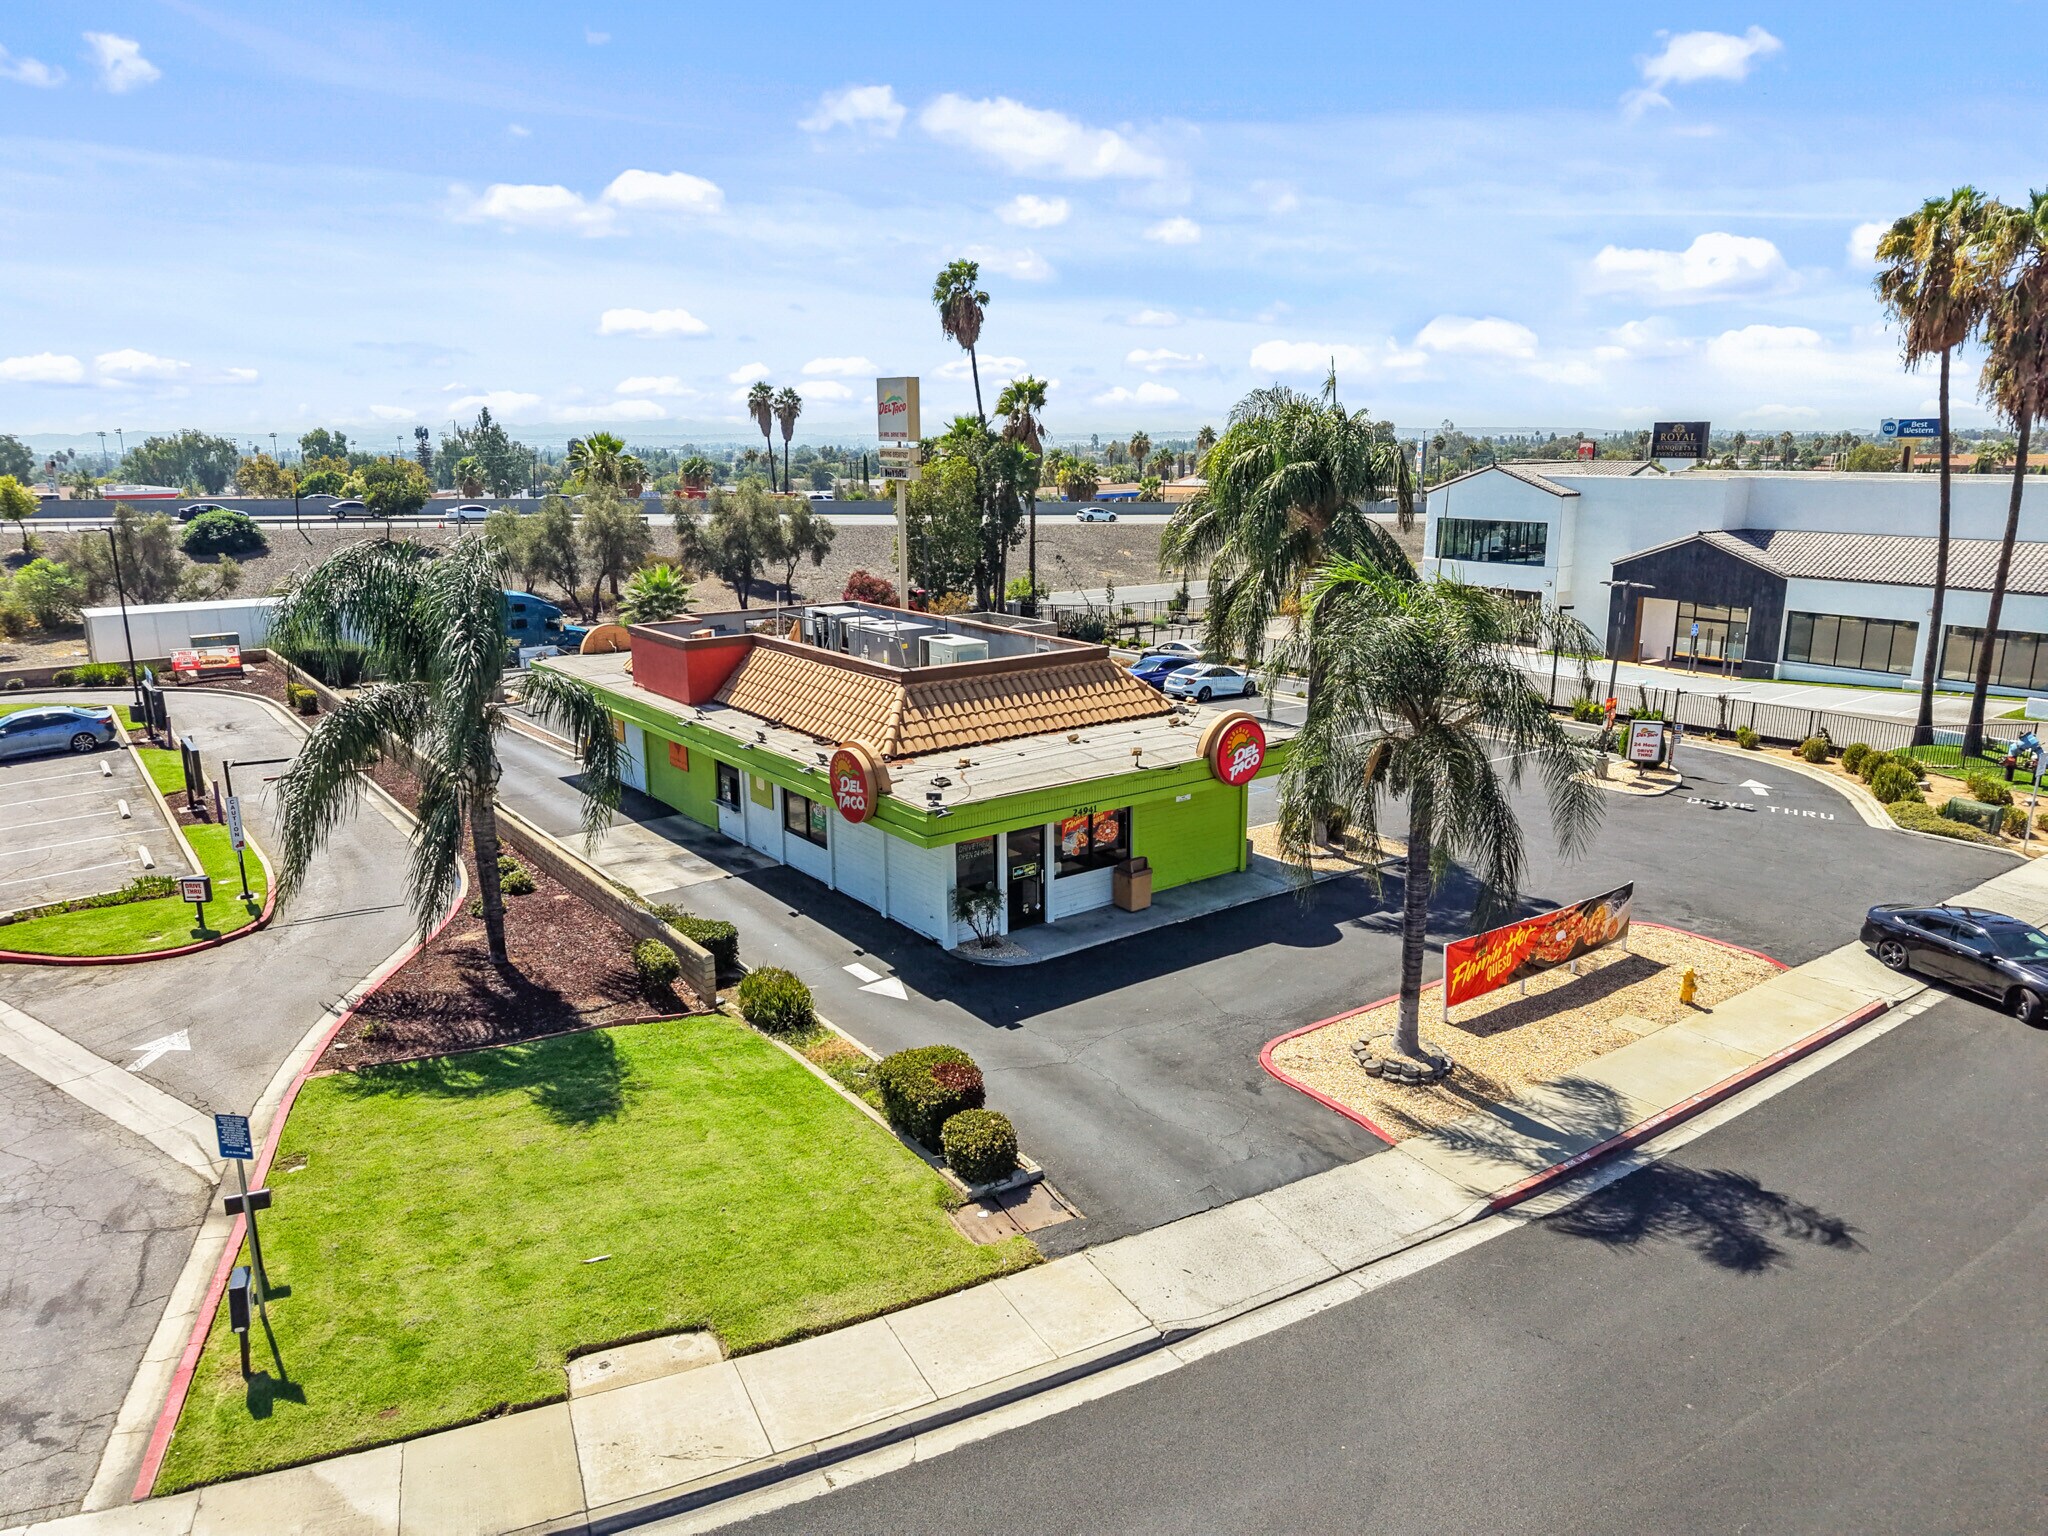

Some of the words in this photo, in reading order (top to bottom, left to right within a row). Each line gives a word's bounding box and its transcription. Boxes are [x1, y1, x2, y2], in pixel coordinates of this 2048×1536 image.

[1911, 420, 1928, 428] Best
[1660, 432, 1697, 441] ROYAL
[1656, 444, 1691, 452] BANQUETS
[1233, 743, 1260, 766] DEL
[1229, 753, 1260, 781] TACO
[840, 776, 863, 793] DEL
[837, 792, 865, 810] TACO
[1686, 796, 1754, 811] DRIVE
[1766, 805, 1835, 821] THRU
[230, 799, 240, 838] CAUTION
[1073, 804, 1097, 817] 24941
[958, 852, 973, 861] OPEN
[1486, 952, 1512, 982] QUESO
